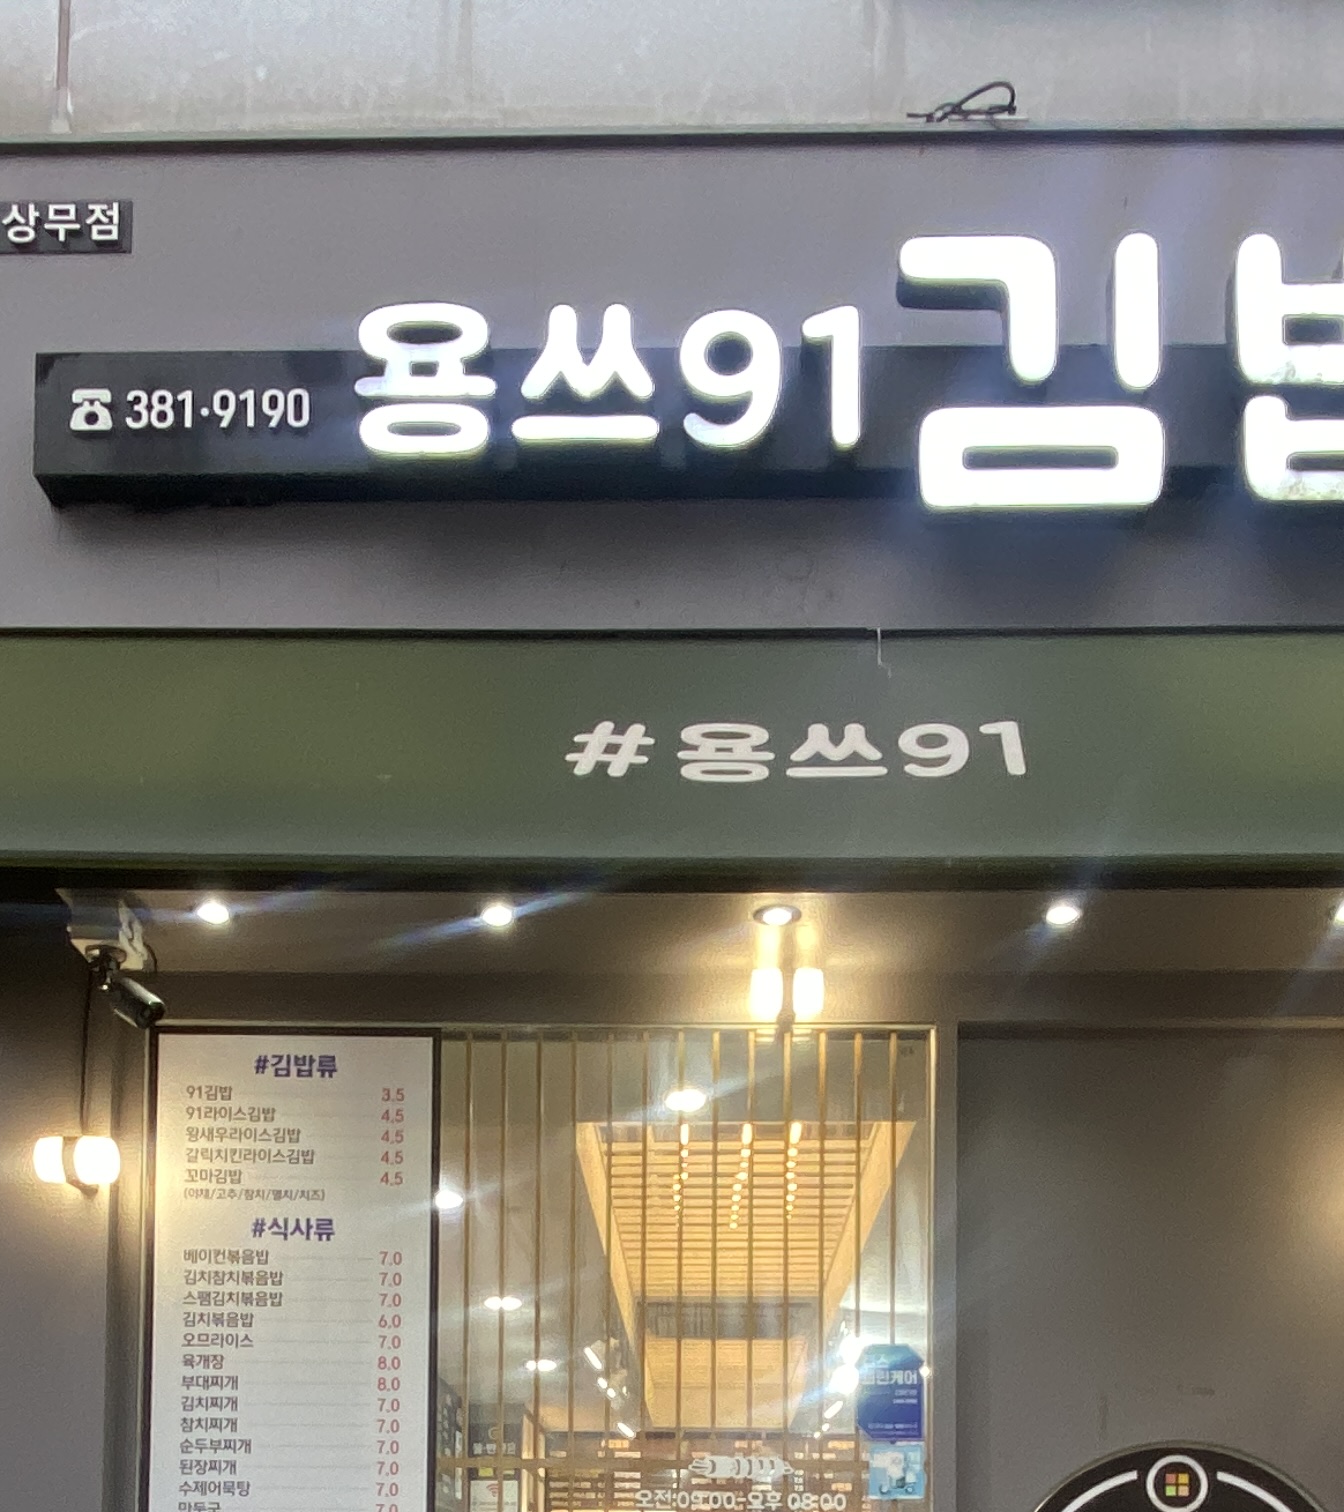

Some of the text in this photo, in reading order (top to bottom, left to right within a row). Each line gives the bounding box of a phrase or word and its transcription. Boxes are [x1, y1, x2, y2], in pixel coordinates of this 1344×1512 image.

[1, 202, 120, 242] 상무점
[354, 302, 862, 458] 용쓰91
[565, 718, 1028, 784] #용쓰91
[254, 1054, 338, 1078] #김밥류
[186, 1085, 405, 1102] 91김밥 3.5
[186, 1107, 404, 1123] 91라이스김밥 4.5
[186, 1127, 404, 1144] 왕새우라이스김밥 4.5
[185, 1148, 404, 1165] 갈릭치킨라이스김밥 4.5
[184, 1169, 404, 1186] 꼬마김밥 4.5
[252, 1217, 335, 1241] #식사류
[184, 1249, 402, 1265] 베이컨볶음밥 7.0
[184, 1270, 402, 1286] 김치참치볶음밥 7.0
[182, 1291, 401, 1307] 스팸김치볶음밥 7.0
[183, 1312, 401, 1328] 김치볶음밥 6.0
[181, 1333, 401, 1349] 오므라이스 7.0
[182, 1354, 401, 1370] 육개장 8.0
[182, 1375, 400, 1391] 부대찌개 8.0
[181, 1396, 400, 1412] 김치찌개 7.0
[180, 1417, 400, 1433] 참치찌개 7.0
[180, 1438, 399, 1454] 순두부찌개 7.0
[179, 1459, 399, 1475] 된장찌개 7.0
[178, 1480, 399, 1497] 수제어묵탕 7.0
